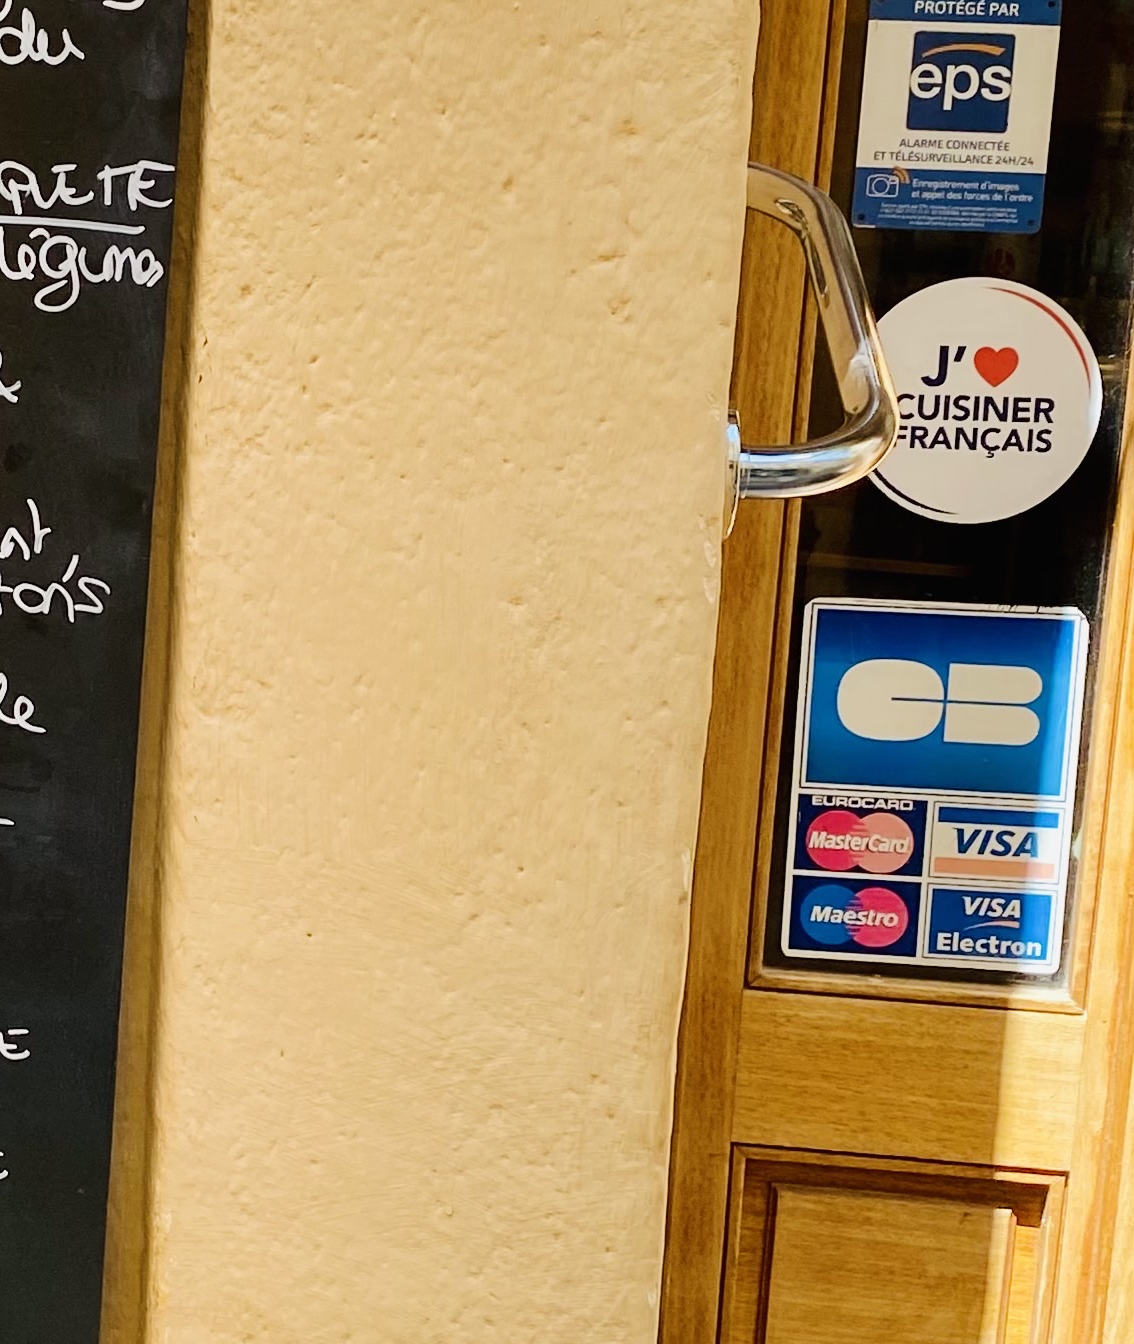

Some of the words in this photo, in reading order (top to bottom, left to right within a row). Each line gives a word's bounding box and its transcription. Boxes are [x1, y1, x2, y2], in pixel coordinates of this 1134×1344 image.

[914, 0, 986, 17] PROTÉGÉ
[988, 3, 1020, 17] PAR
[909, 61, 1012, 112] eps
[899, 139, 943, 149] ALARME
[946, 140, 1010, 152] CONNECTÉE
[873, 151, 886, 162] ET
[889, 151, 993, 165] TÉLÉSURVEILLANCE
[995, 156, 1034, 166] 24H/24
[946, 191, 962, 200] des
[991, 193, 1004, 202] de
[896, 393, 1055, 424] CUISINER
[836, 658, 1043, 746] CB
[811, 795, 914, 811] EUROCARD
[808, 830, 910, 855] MasterCard
[953, 827, 1039, 857] VISA
[810, 905, 900, 928] Maestro
[962, 895, 1021, 919] VISA
[936, 932, 1042, 956] Electron
